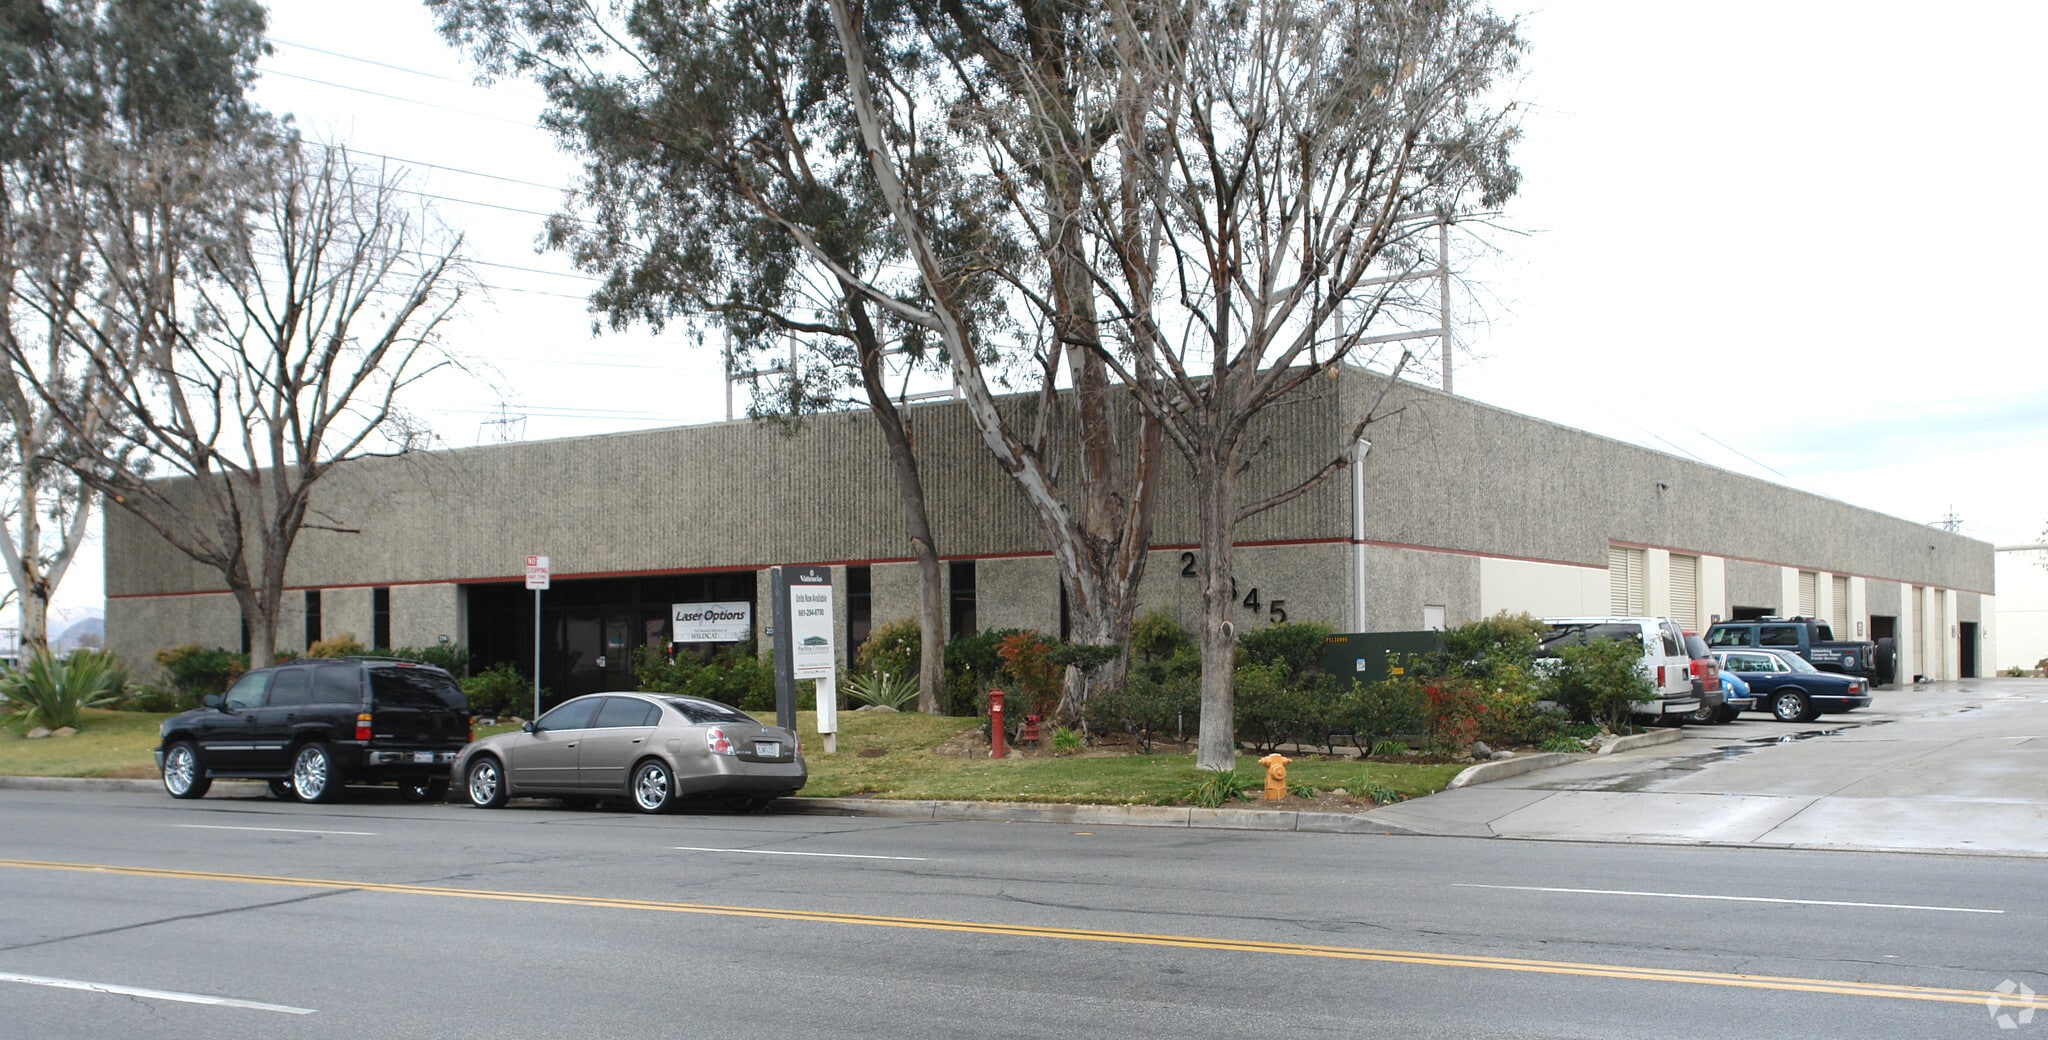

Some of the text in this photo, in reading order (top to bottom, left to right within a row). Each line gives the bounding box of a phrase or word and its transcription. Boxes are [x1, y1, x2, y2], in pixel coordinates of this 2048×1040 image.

[528, 557, 536, 565] NO
[799, 574, 823, 582] Valencia
[812, 594, 828, 603] Available
[675, 610, 745, 624] Laser Options
